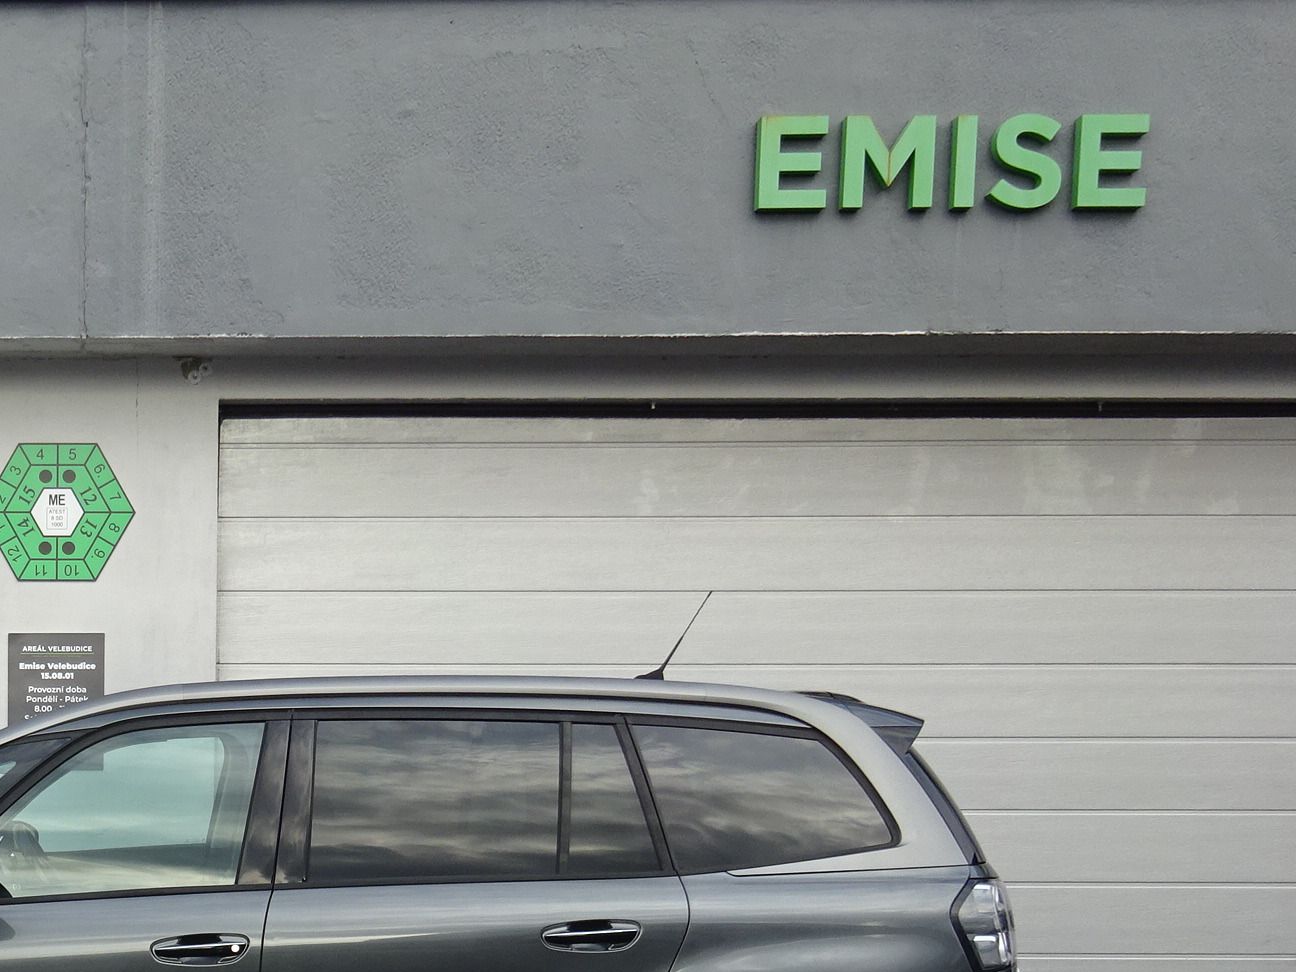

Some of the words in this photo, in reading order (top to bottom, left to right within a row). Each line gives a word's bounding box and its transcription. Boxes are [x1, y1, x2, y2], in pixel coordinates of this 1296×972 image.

[754, 113, 1151, 213] EMISE
[36, 448, 45, 460] 4
[68, 448, 77, 461] 5
[9, 465, 22, 476] 3
[18, 485, 36, 505] 15
[48, 494, 66, 506] ME
[79, 486, 98, 506] 12
[109, 493, 121, 502] 7
[17, 517, 35, 537] 14
[80, 519, 98, 538] 13
[108, 522, 120, 533] 8
[7, 545, 23, 563] 12
[35, 565, 48, 576] 11
[64, 564, 80, 577] 10
[22, 644, 47, 652] AREÁL
[19, 662, 45, 670] Emise
[47, 662, 96, 670] Velebudice
[40, 672, 74, 680] 15.08.01
[28, 685, 64, 693] Provozní
[65, 685, 87, 693] doba
[26, 695, 58, 703] Pondělí
